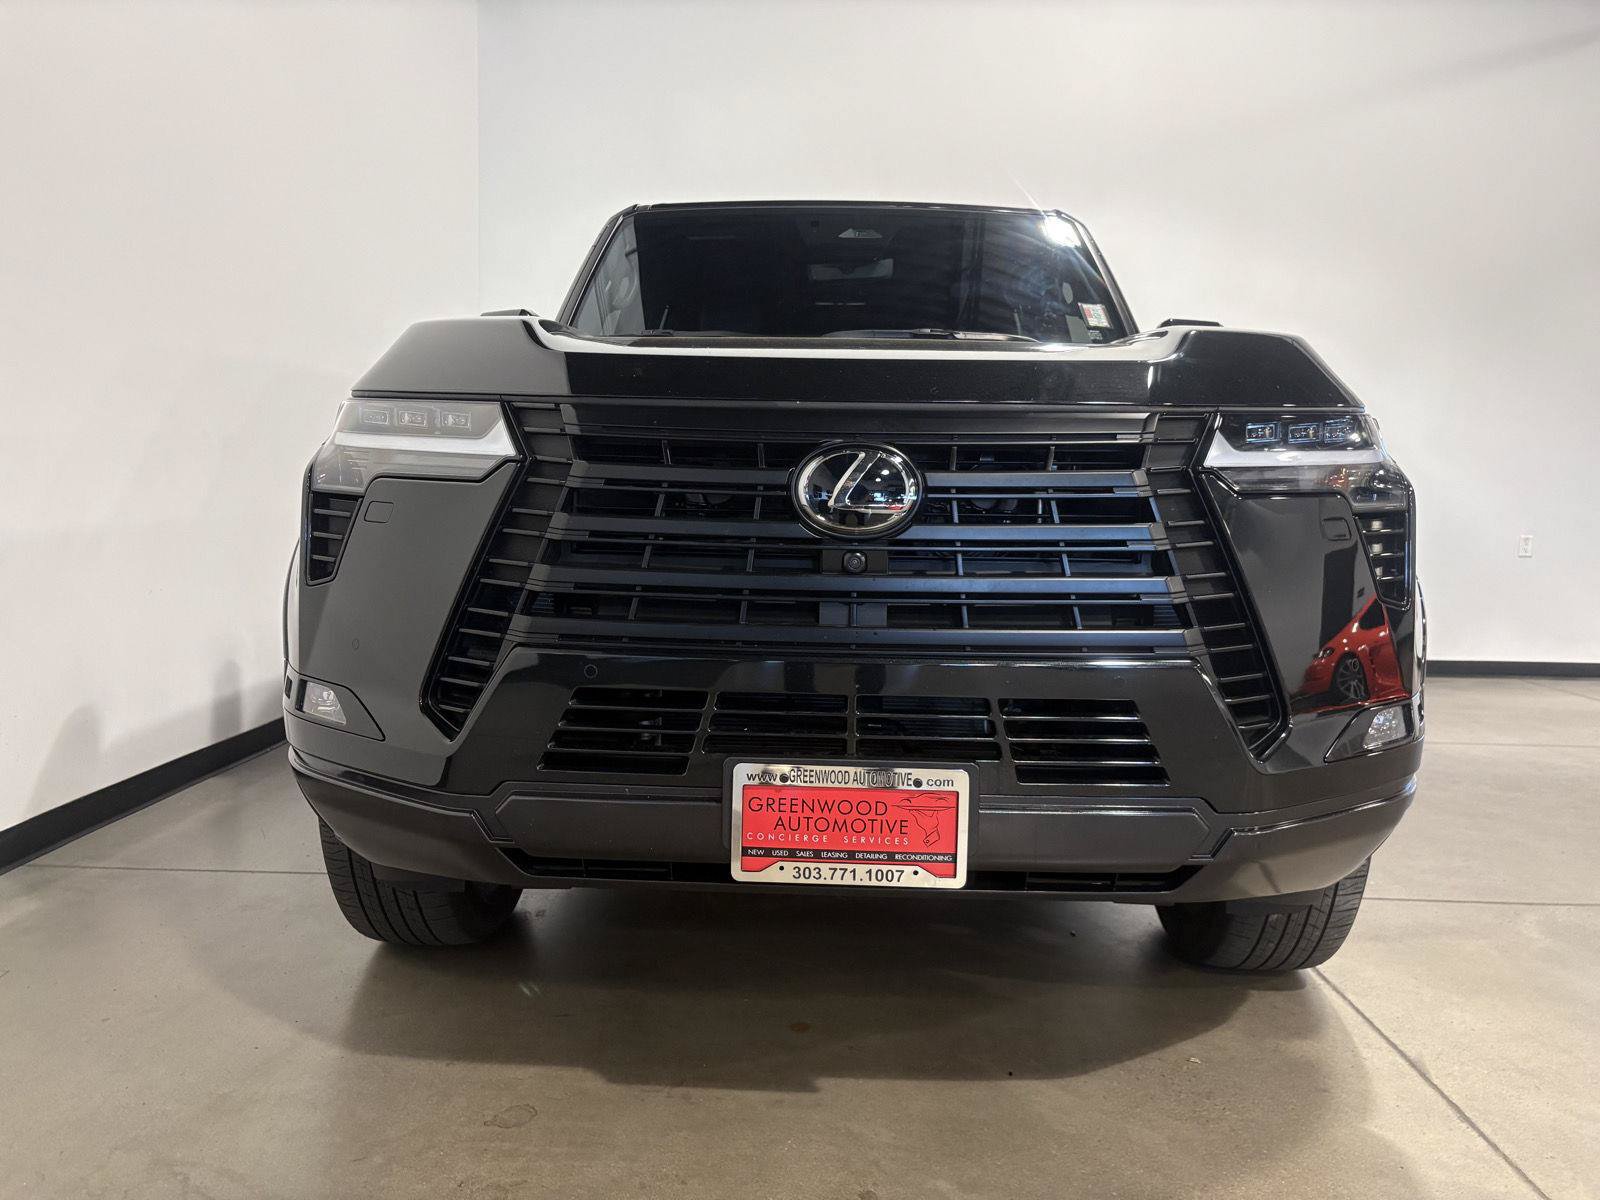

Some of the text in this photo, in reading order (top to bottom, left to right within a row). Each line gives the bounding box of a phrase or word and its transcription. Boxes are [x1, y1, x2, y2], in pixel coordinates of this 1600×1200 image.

[789, 768, 850, 785] GREENWOOD
[852, 770, 913, 787] AUTOMOTIVE
[748, 796, 888, 816] GREENWOOD
[773, 816, 909, 835] AUTOMOTIVE
[746, 832, 910, 845] CONCIERGE SERVICES
[772, 849, 789, 857] USED
[821, 851, 848, 859] LEASING
[855, 852, 888, 860] DETAILING
[895, 853, 953, 861] RECONDITIONING
[792, 865, 905, 883] 303.771.1007
